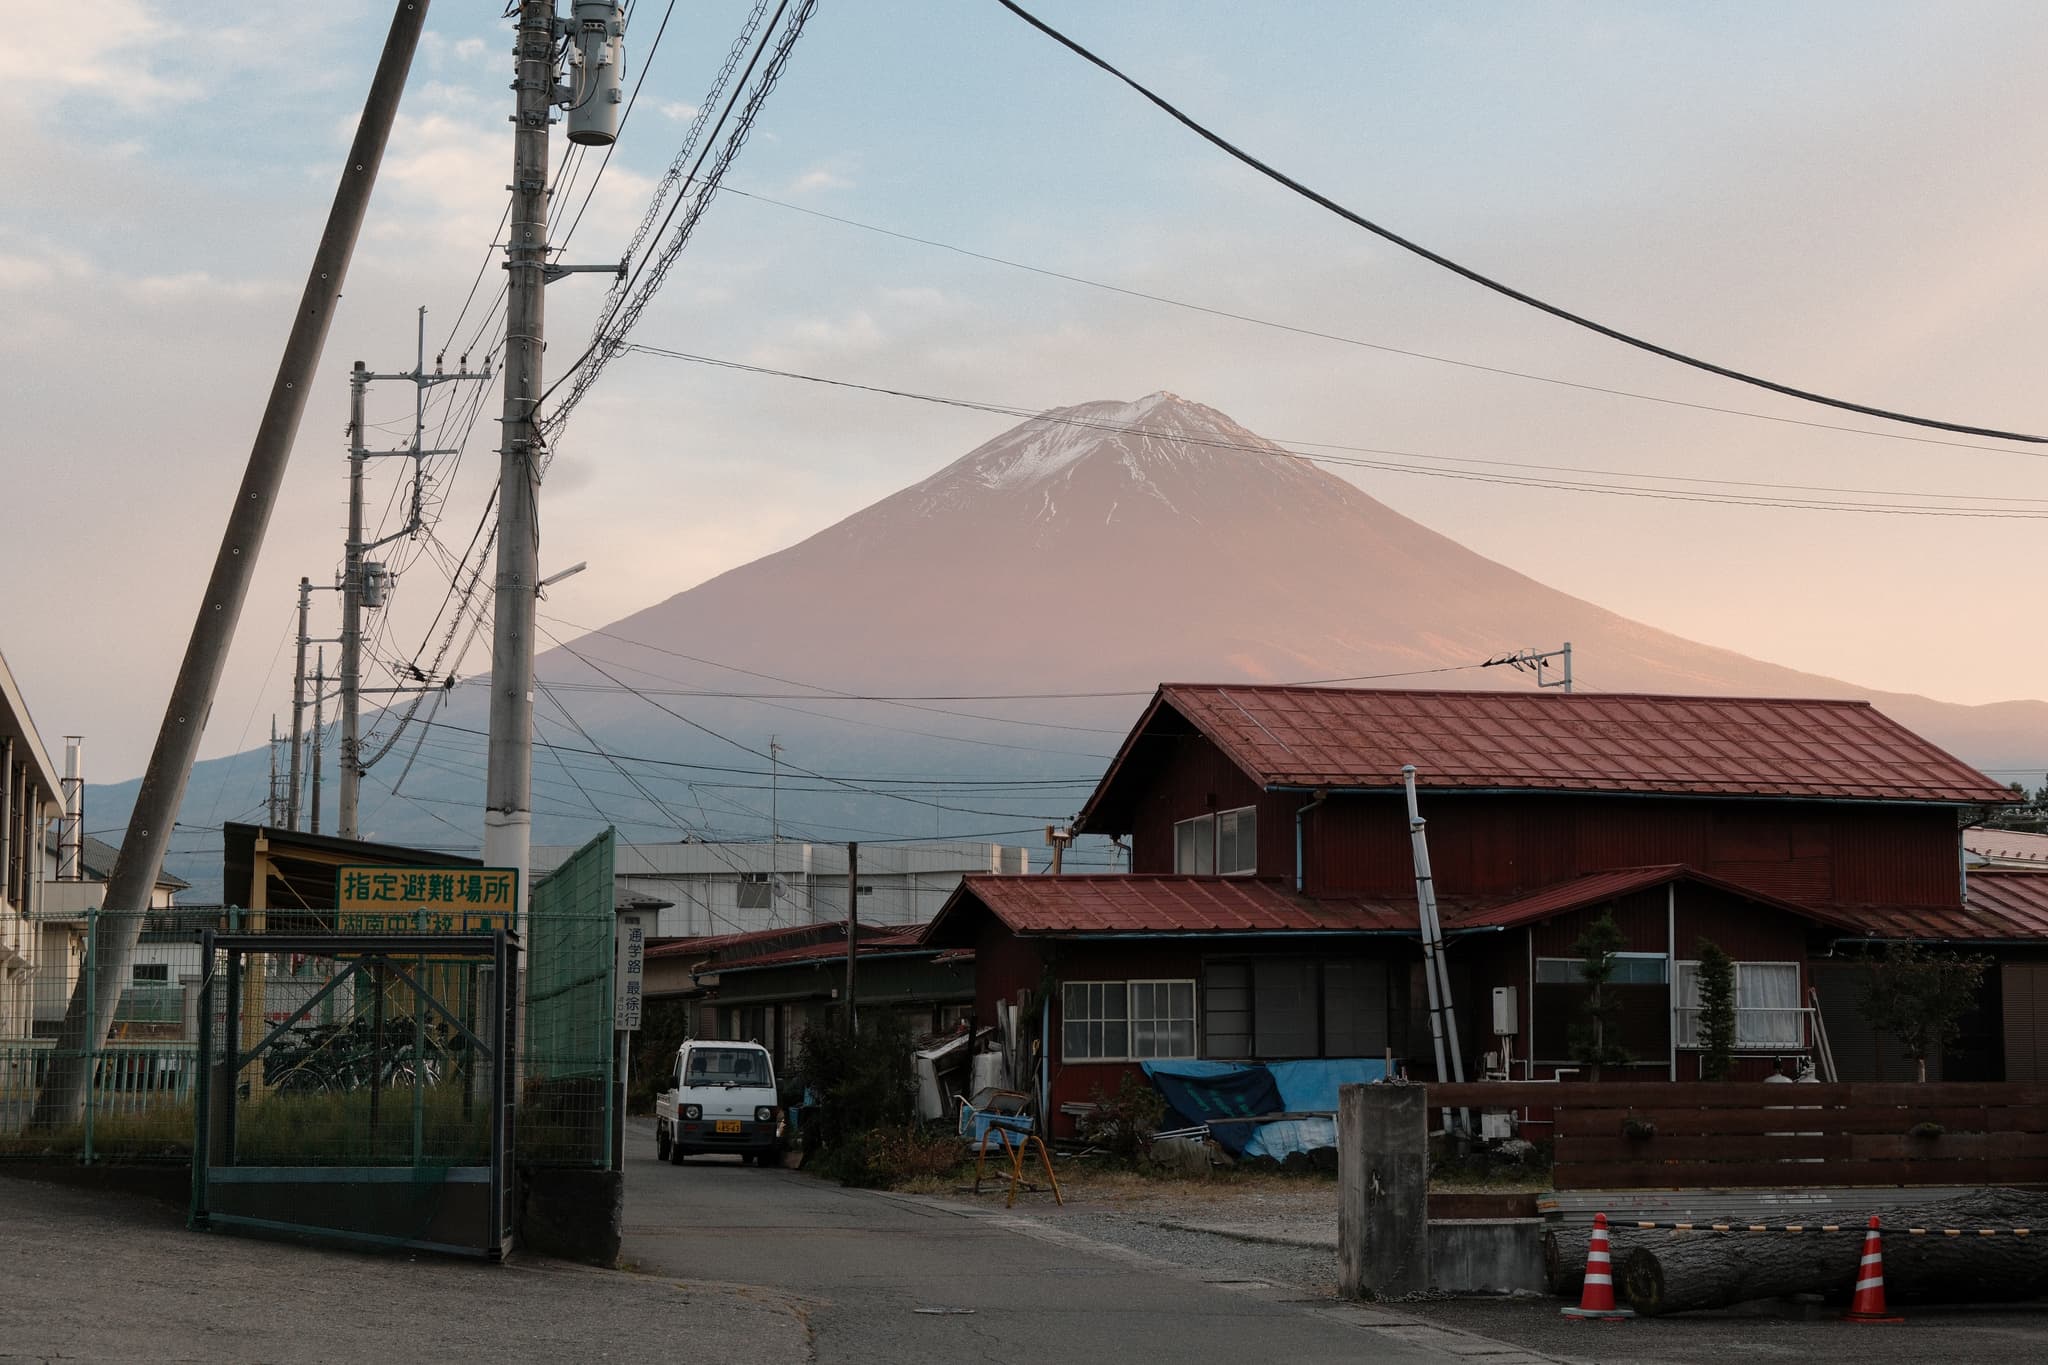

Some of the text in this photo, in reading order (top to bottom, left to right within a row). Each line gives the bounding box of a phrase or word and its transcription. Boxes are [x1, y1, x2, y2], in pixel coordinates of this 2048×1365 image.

[344, 872, 510, 903] 指定避難場所
[627, 928, 642, 974] 通学路
